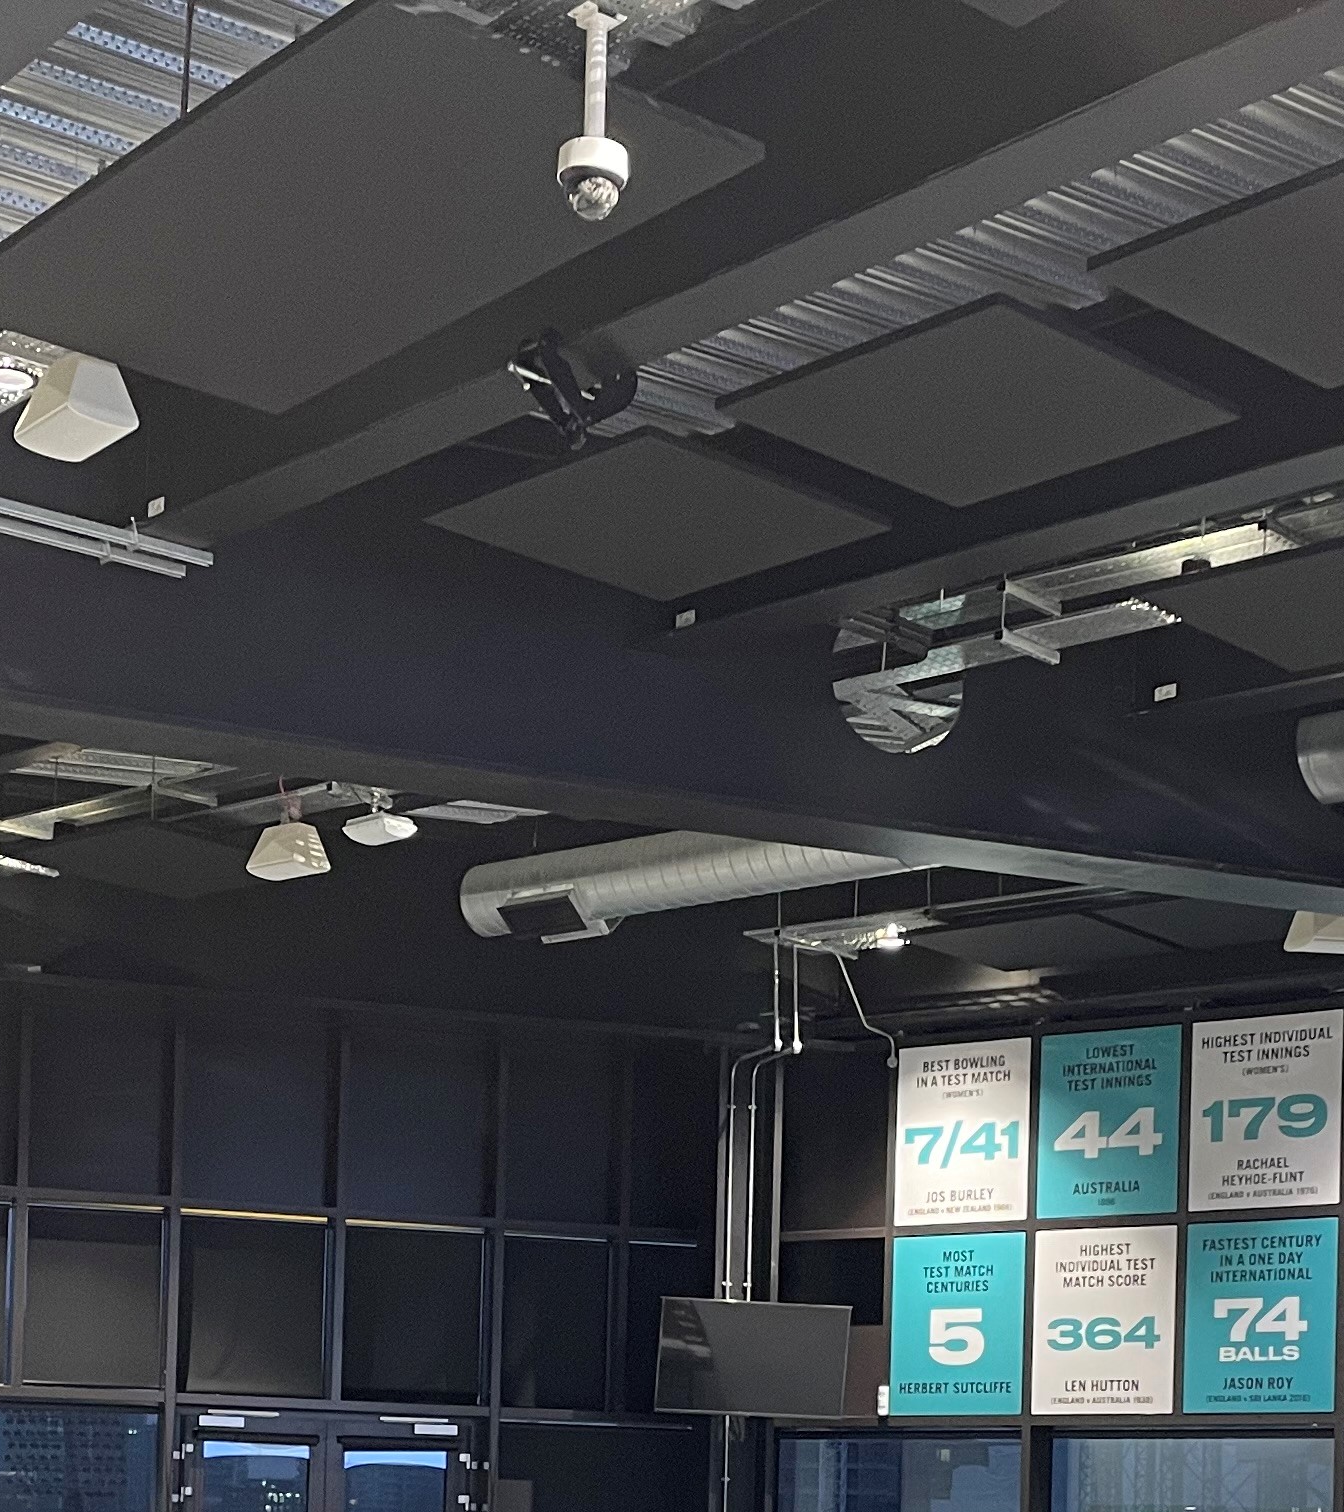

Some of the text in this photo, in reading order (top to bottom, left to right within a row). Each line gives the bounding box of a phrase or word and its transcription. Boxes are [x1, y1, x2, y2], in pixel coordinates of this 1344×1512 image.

[1202, 1027, 1333, 1049] HIGHEST INDIVIDUAL
[1086, 1044, 1134, 1059] LOWEST
[1223, 1045, 1310, 1063] TEST INNINGS
[923, 1055, 1006, 1072] BEST BOWLING
[1063, 1058, 1157, 1077] INTERNATIONAL
[1242, 1065, 1289, 1076] (WOMEN'S)
[916, 1070, 1011, 1088] IN A TEST MATCH
[1067, 1074, 1152, 1092] TEST INNINGS
[1202, 1094, 1328, 1142] 179
[1054, 1107, 1163, 1158] 44
[905, 1120, 1019, 1169] 7/41
[1237, 1157, 1289, 1170] RACHAEL
[1222, 1171, 1304, 1186] HEYHOE-FLINT
[1073, 1180, 1140, 1195] AUSTRALIA
[1208, 1191, 1244, 1200] (ENGLAND
[1253, 1188, 1293, 1198] AUSTRALIA
[926, 1188, 994, 1203] JOS BURLEY
[1080, 1243, 1131, 1257] HIGHEST
[1203, 1235, 1322, 1251] FASTEST CENTURY
[943, 1250, 974, 1262] MOST
[1220, 1252, 1303, 1266] IN A ONE DAY
[923, 1265, 994, 1278] TEST MATCH
[1056, 1258, 1156, 1273] INDIVIDUAL TEST
[1063, 1274, 1147, 1288] MATCH SCORE
[1211, 1268, 1312, 1283] INTERNATIONAL
[926, 1280, 989, 1293] CENTURIES
[1214, 1296, 1308, 1342] 74
[929, 1307, 984, 1366] 5
[1047, 1316, 1160, 1351] 364
[1219, 1345, 1300, 1362] BALLS
[899, 1381, 1012, 1394] HERBERT SUTCLIFFE
[1065, 1380, 1139, 1392] LEN HUTTON
[1223, 1377, 1293, 1390] JASON ROY
